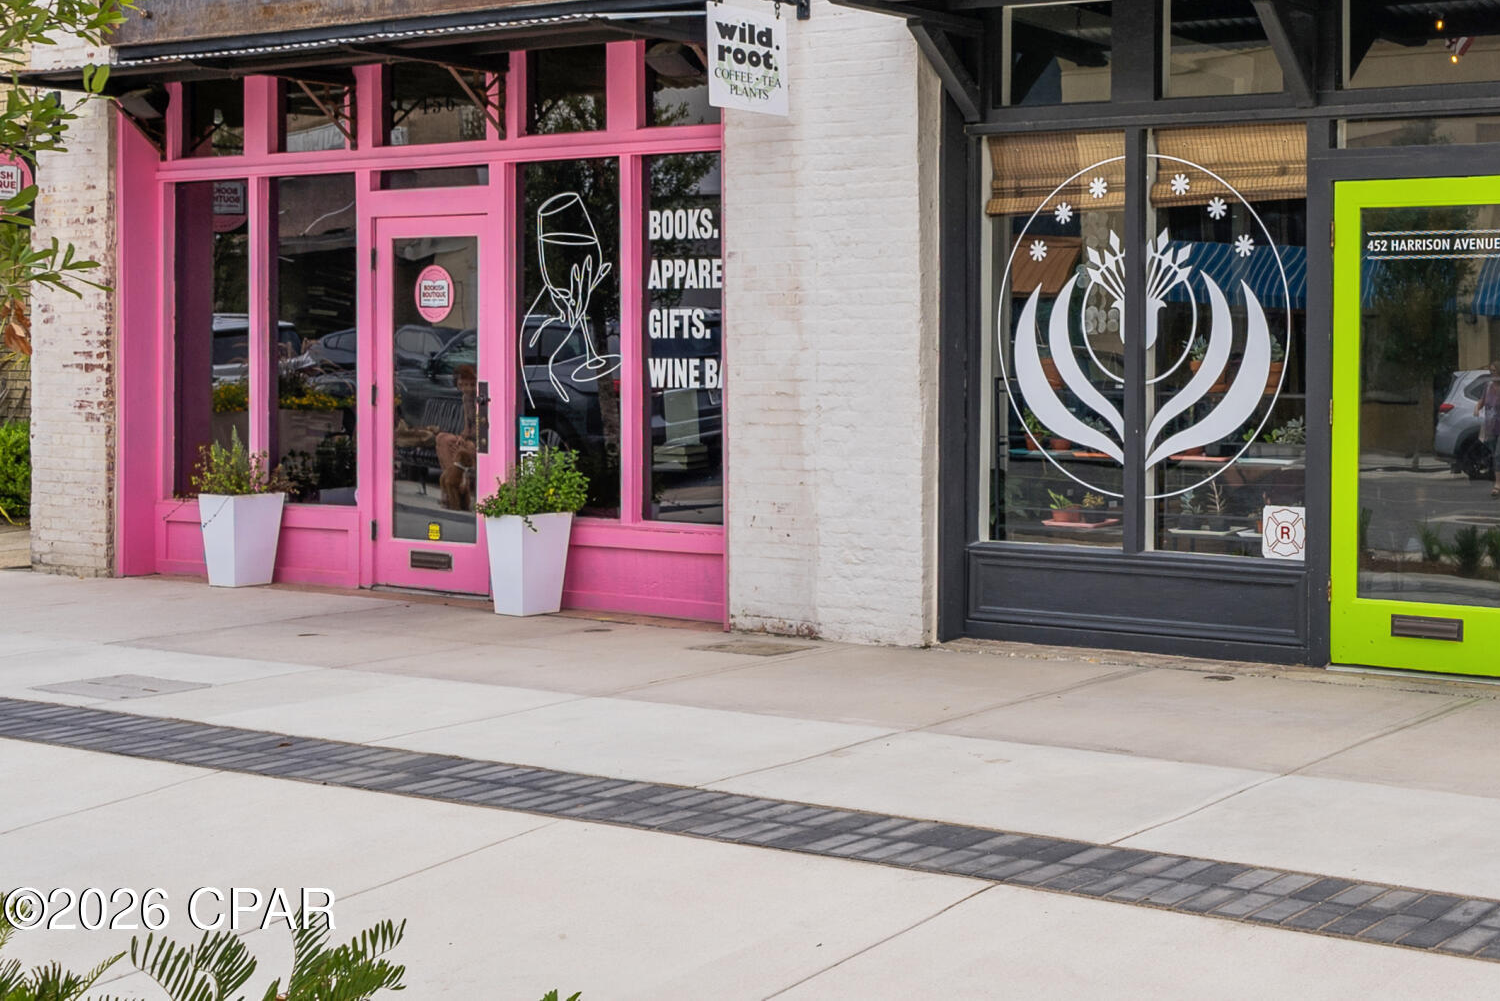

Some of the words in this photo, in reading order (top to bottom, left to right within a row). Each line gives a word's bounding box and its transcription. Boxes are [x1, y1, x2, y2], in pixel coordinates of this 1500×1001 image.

[715, 21, 780, 51] wild.
[718, 44, 779, 72] root.
[714, 67, 753, 83] COFFEE
[762, 75, 782, 88] TEA
[729, 84, 769, 100] PLANTS
[648, 208, 719, 240] BOOKS.
[1367, 240, 1388, 251] 452
[1391, 239, 1450, 251] HARRISON
[1453, 238, 1500, 250] AVENUE
[648, 308, 711, 339] GIFTS.
[648, 358, 700, 388] WINE
[1281, 526, 1290, 540] R
